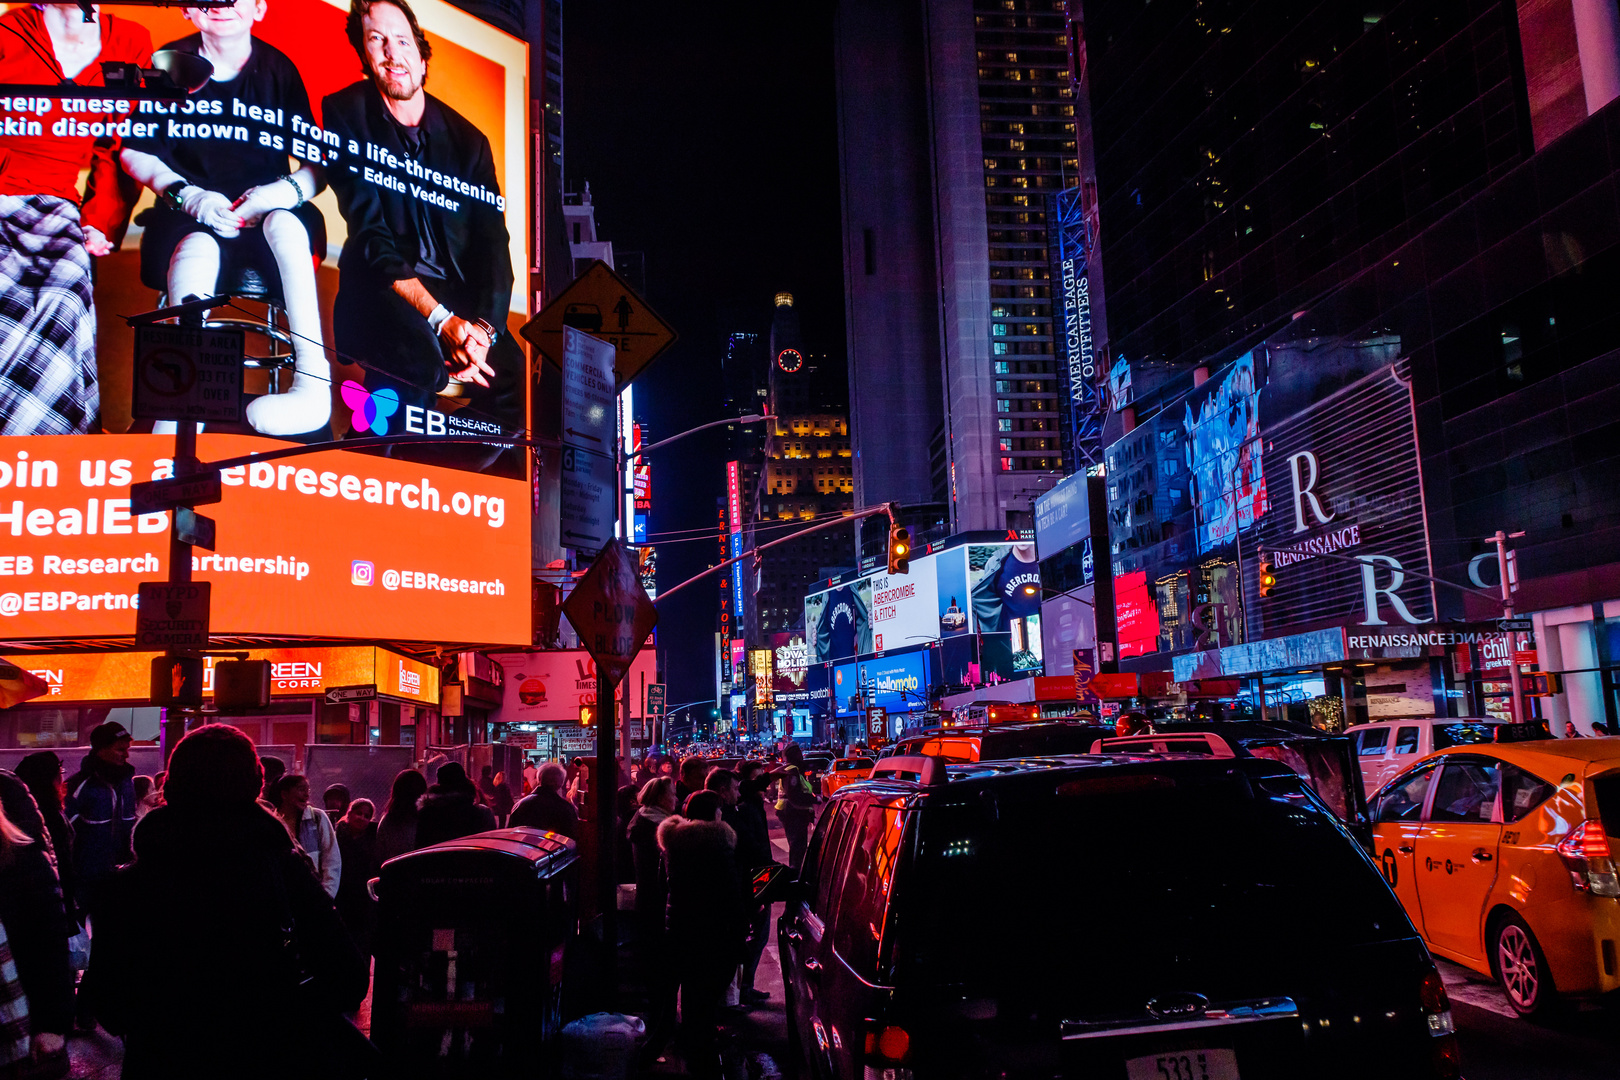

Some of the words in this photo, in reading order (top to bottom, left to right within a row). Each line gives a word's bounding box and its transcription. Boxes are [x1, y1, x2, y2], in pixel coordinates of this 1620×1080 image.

[52, 117, 159, 138] disorder
[168, 119, 248, 141] known
[259, 131, 284, 150] as
[232, 98, 283, 127] heal
[291, 115, 340, 148] from
[348, 139, 359, 155] a
[366, 142, 505, 212] life-threatening
[364, 166, 406, 194] Eddie
[410, 182, 460, 212] Vedder
[1063, 258, 1077, 308] EAGLE
[1076, 277, 1094, 378] OUTFITTERS
[210, 337, 237, 349] AREA
[199, 353, 236, 366] TRUCKS
[1066, 313, 1083, 401] AMERICAN
[204, 389, 229, 400] OVER
[405, 404, 446, 436] EB
[448, 415, 502, 435] RESEARCH
[563, 449, 573, 469] 6
[79, 459, 133, 487] us
[220, 452, 505, 528] ebresearch.org
[1287, 450, 1335, 534] R
[1273, 525, 1361, 570] RENAISSANCE
[43, 553, 159, 575] Research
[191, 553, 310, 580] artnership
[381, 568, 505, 596] @EBResearch
[873, 579, 883, 591] THIS
[884, 577, 889, 588] IS
[1004, 573, 1040, 597] ABERCRO
[874, 583, 915, 605] ABERCROMBIE
[1355, 555, 1433, 626] R
[874, 610, 879, 621] &
[880, 605, 896, 620] FITCH
[721, 600, 730, 660] YOUNG
[1349, 633, 1446, 649] RENAISSANCE
[1486, 658, 1503, 669] greek
[277, 680, 321, 688] CORP.
[810, 687, 829, 699] swatch
[877, 674, 918, 694] hellomoto
[871, 709, 883, 734] tkts
